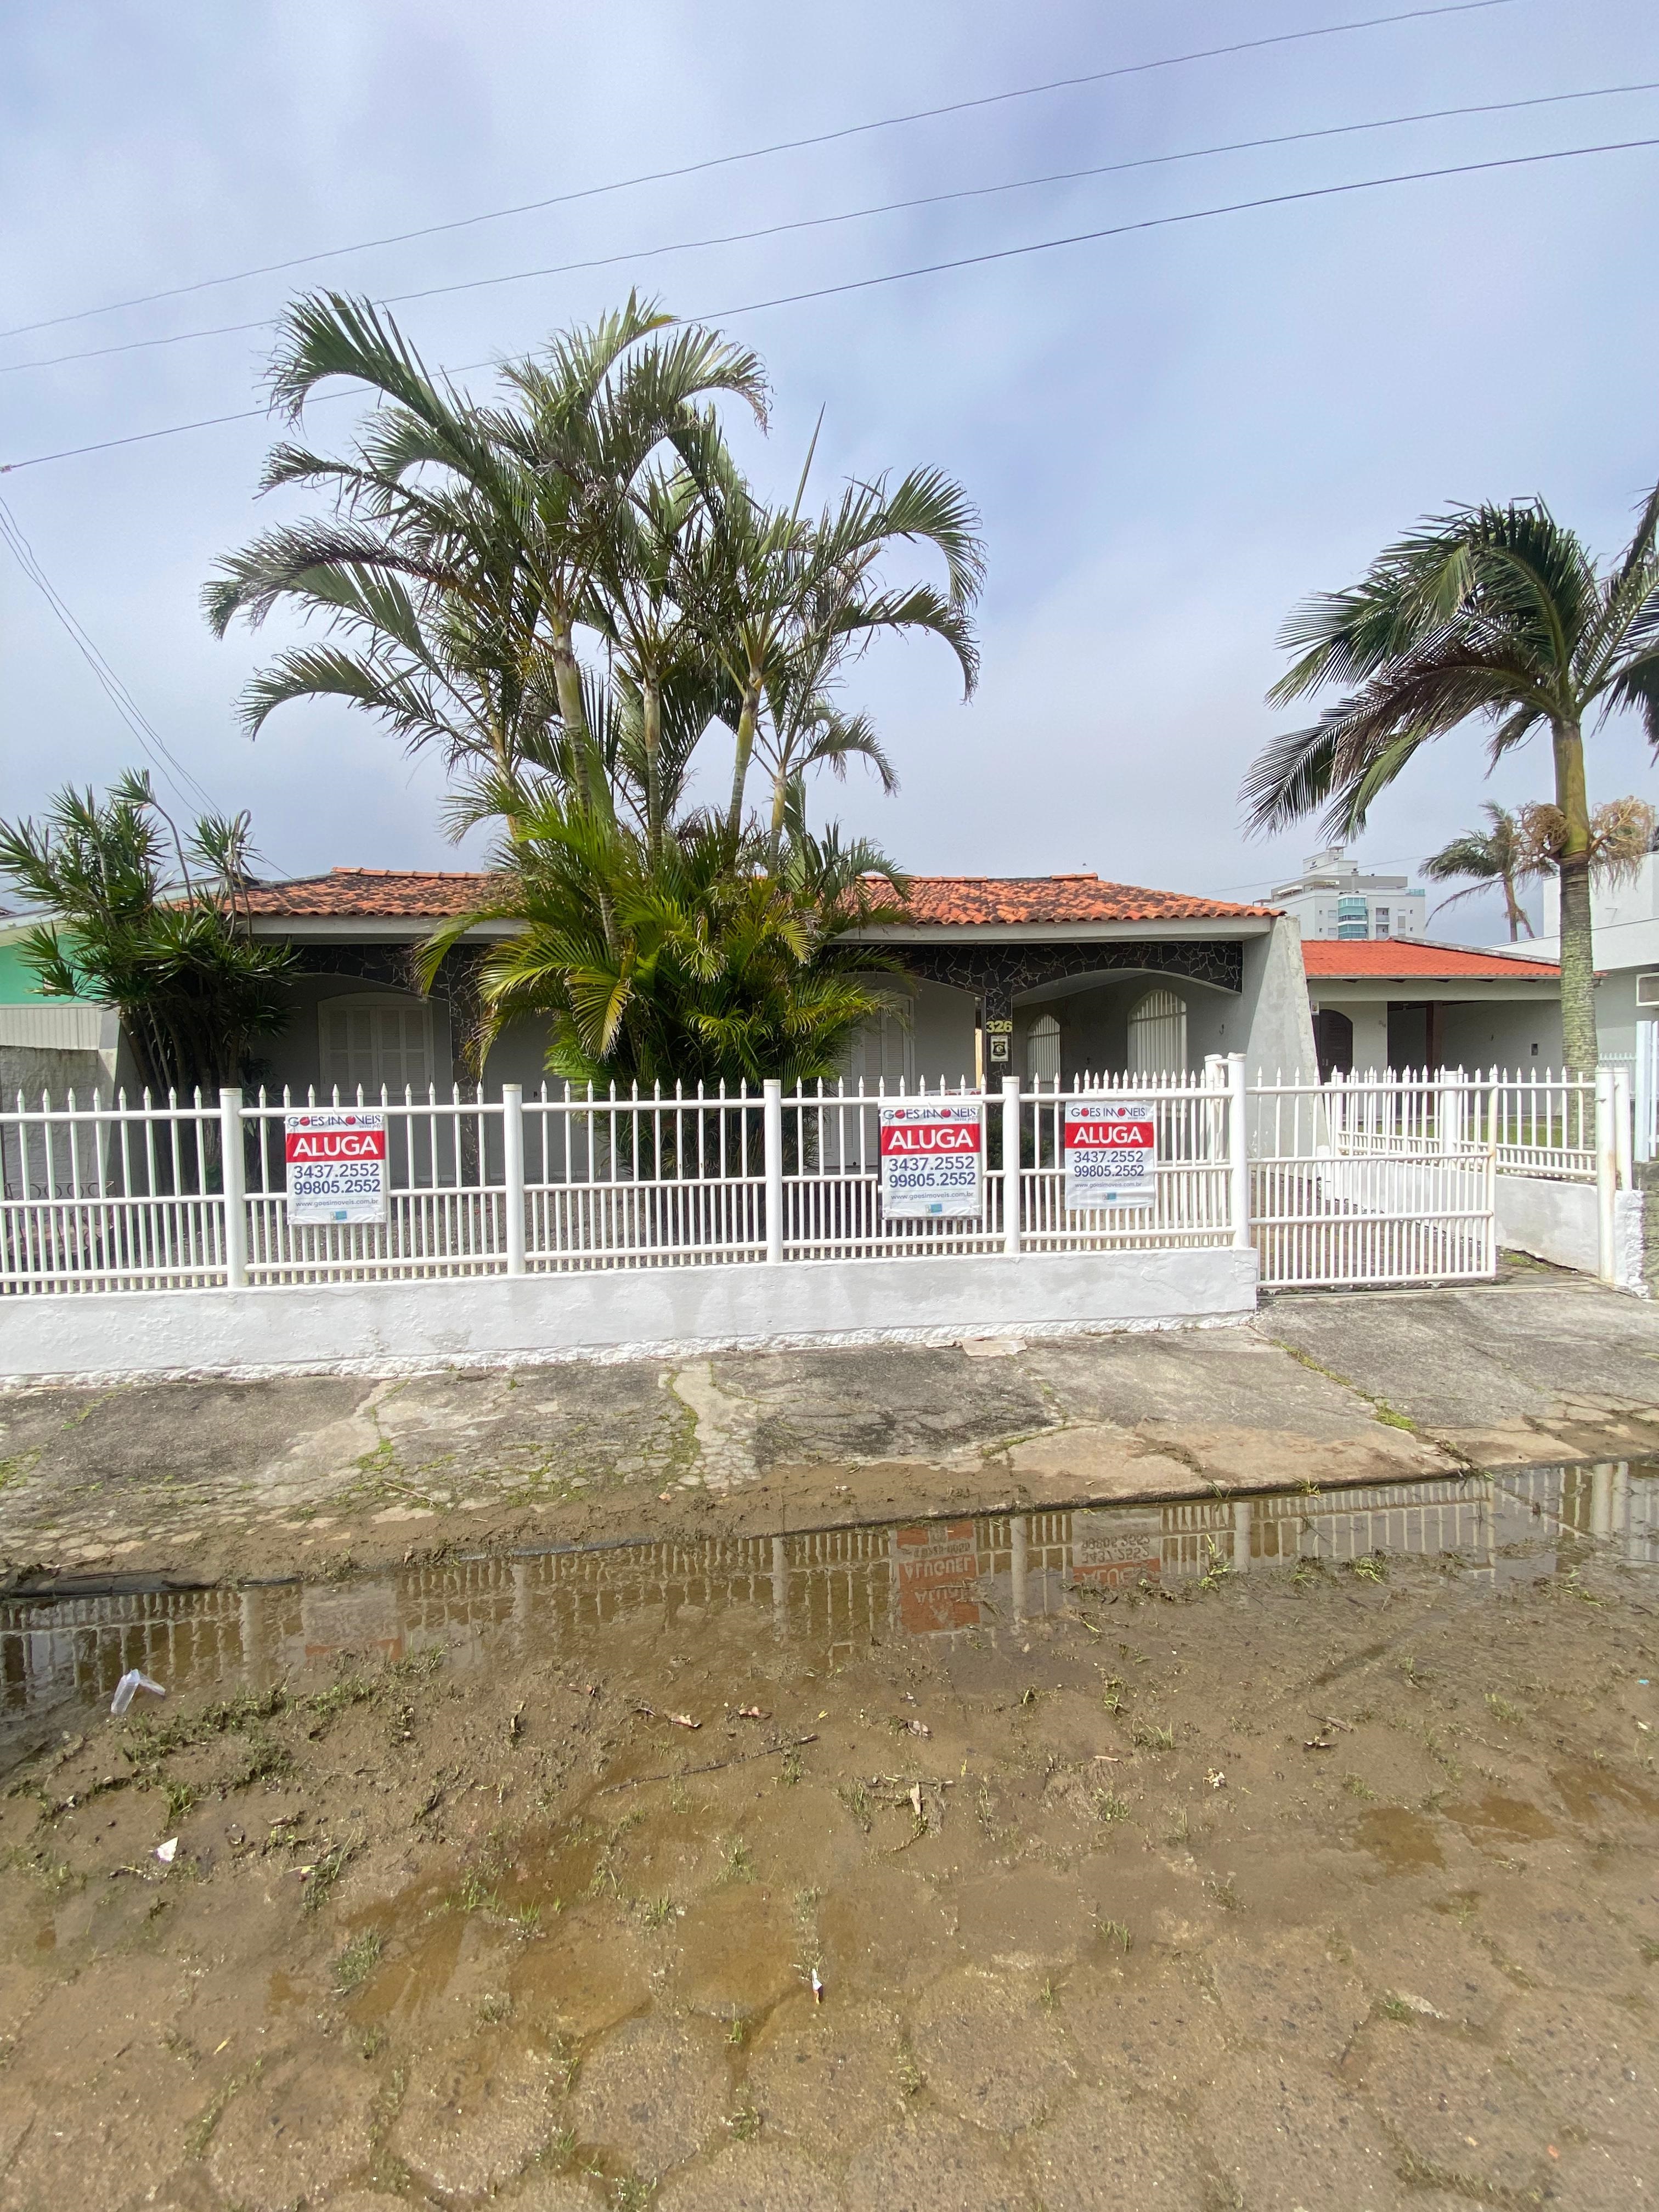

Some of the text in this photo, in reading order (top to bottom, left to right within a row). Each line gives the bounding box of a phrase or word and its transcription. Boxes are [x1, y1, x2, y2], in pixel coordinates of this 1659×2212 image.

[986, 1020, 1013, 1033] 326
[888, 1128, 974, 1150] ALUGA
[1073, 1126, 1143, 1144] ALUGA
[292, 1136, 379, 1157] ALUGA
[889, 1156, 974, 1172] 3437.2552
[1074, 1151, 1143, 1163] 3437.2552
[294, 1163, 380, 1179] 3437.2552
[1074, 1165, 1144, 1177] 99805.2552
[294, 1179, 380, 1195] 99805.2552
[889, 1172, 975, 1188] 99805.2552
[296, 1198, 379, 1207] www.goesimoveis.com.br
[891, 1191, 974, 1200] www.goesimoveis.com.br
